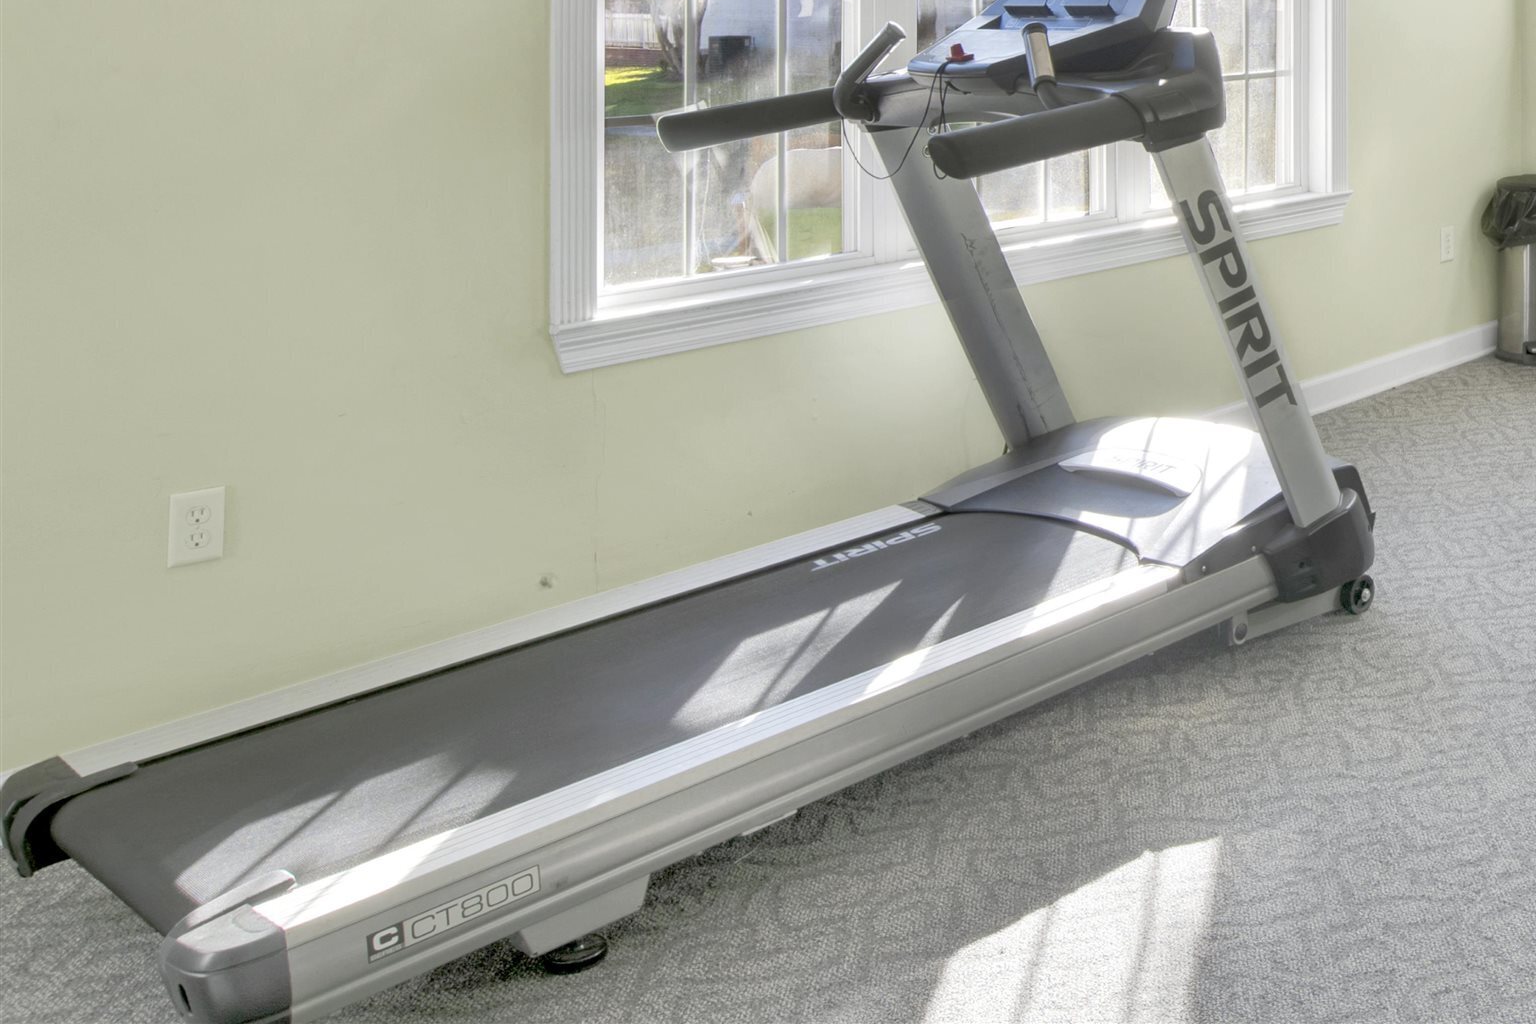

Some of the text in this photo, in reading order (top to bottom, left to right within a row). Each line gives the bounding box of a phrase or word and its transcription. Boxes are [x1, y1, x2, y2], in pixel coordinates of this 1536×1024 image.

[1179, 189, 1298, 408] SPIRIT
[811, 522, 942, 572] SPIRIT
[411, 873, 534, 940] CT800
